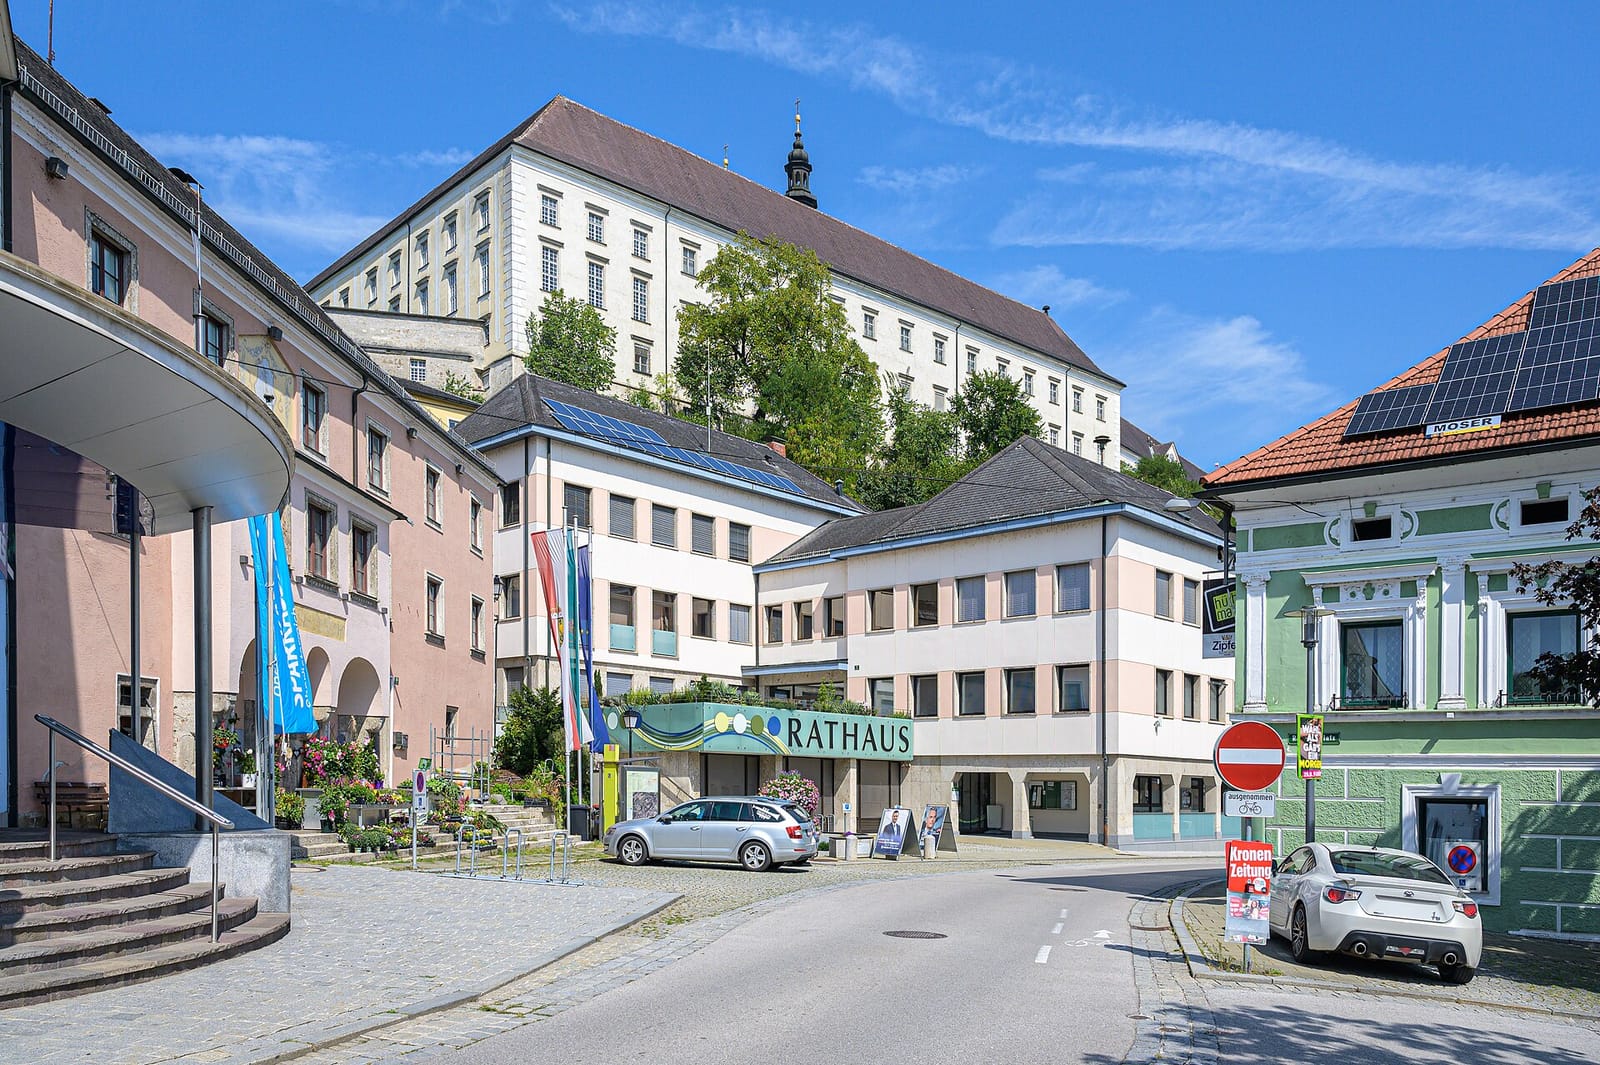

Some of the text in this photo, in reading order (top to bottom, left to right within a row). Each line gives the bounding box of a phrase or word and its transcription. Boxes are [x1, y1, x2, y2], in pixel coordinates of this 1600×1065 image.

[1434, 418, 1492, 432] MOSER
[788, 717, 910, 753] RATHAUS
[1306, 733, 1318, 742] ALS
[1228, 793, 1273, 801] ausgenommen
[1230, 846, 1271, 861] Kronen
[1230, 863, 1271, 879] Zeitung
